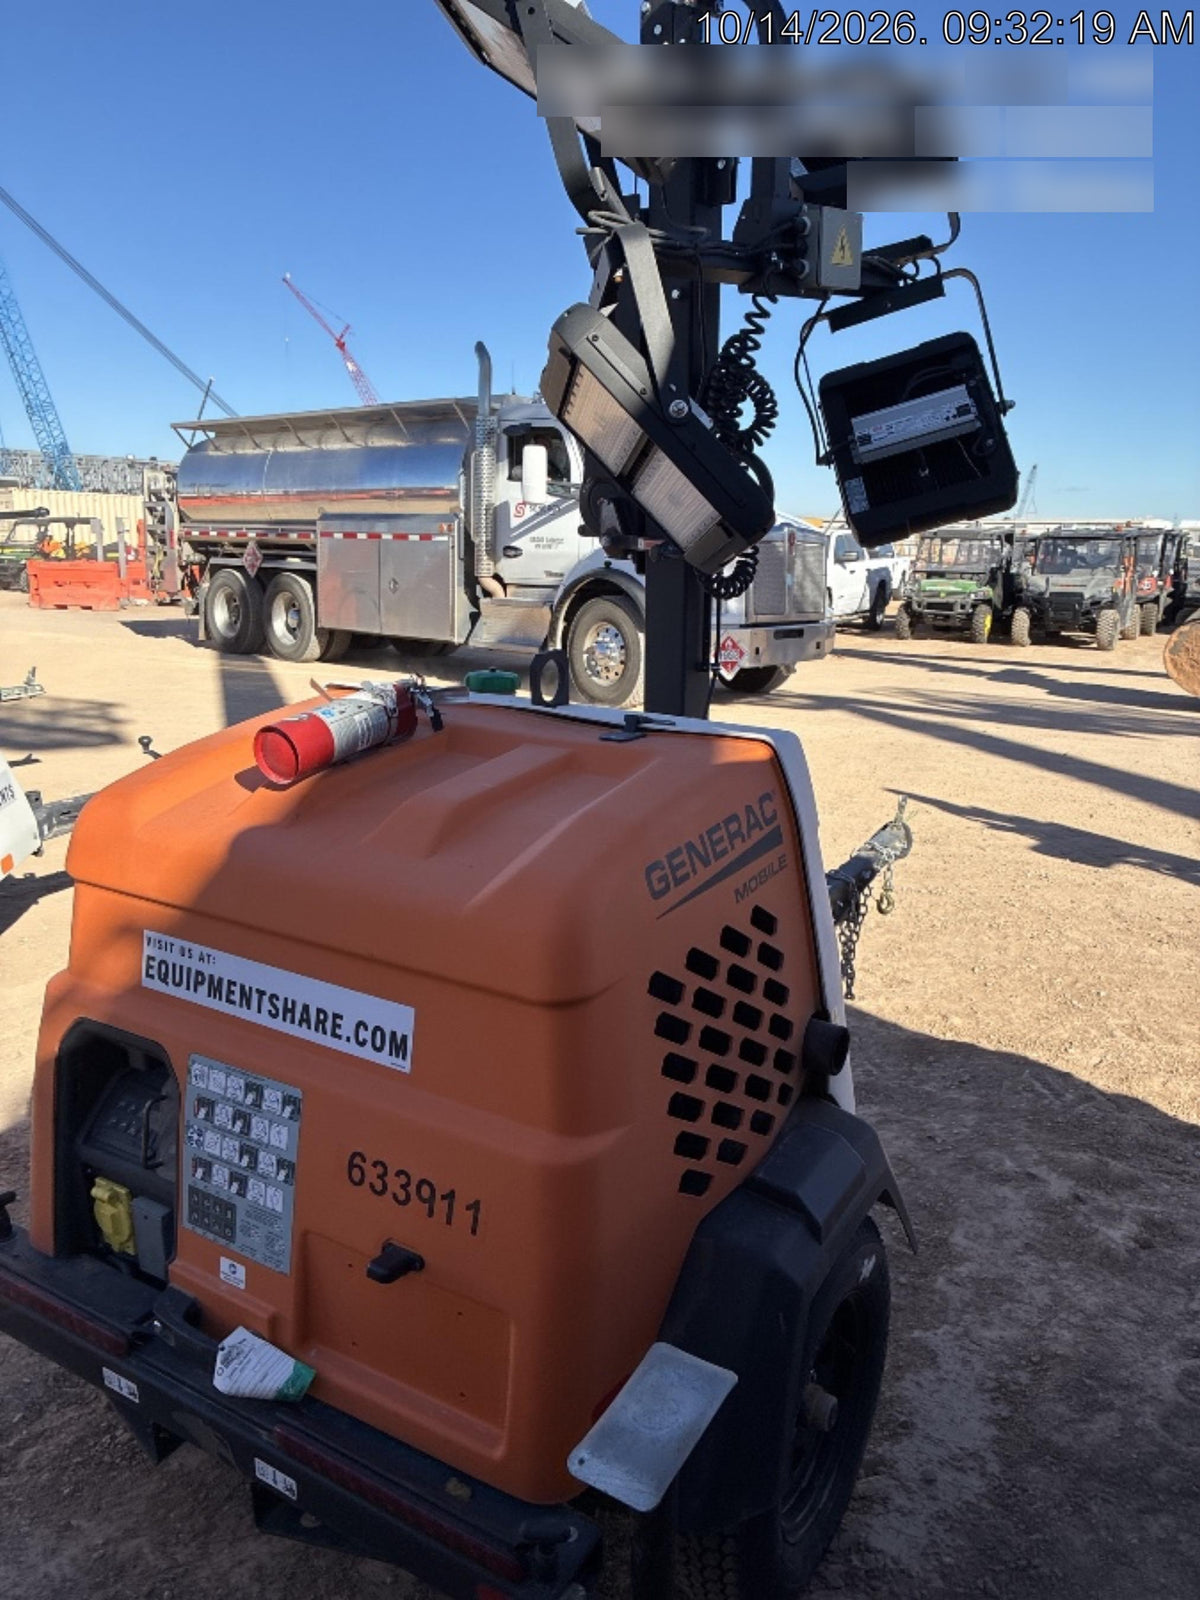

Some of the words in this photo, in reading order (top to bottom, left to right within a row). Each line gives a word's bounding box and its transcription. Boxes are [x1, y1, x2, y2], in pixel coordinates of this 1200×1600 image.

[644, 792, 778, 900] GENERAC
[733, 854, 788, 903] MOBILE
[145, 936, 175, 954] VISIT
[179, 946, 193, 960] US
[198, 951, 216, 966] AT:
[144, 955, 409, 1061] EQUIPMENTSHARE.COM
[347, 1151, 481, 1236] 633911
